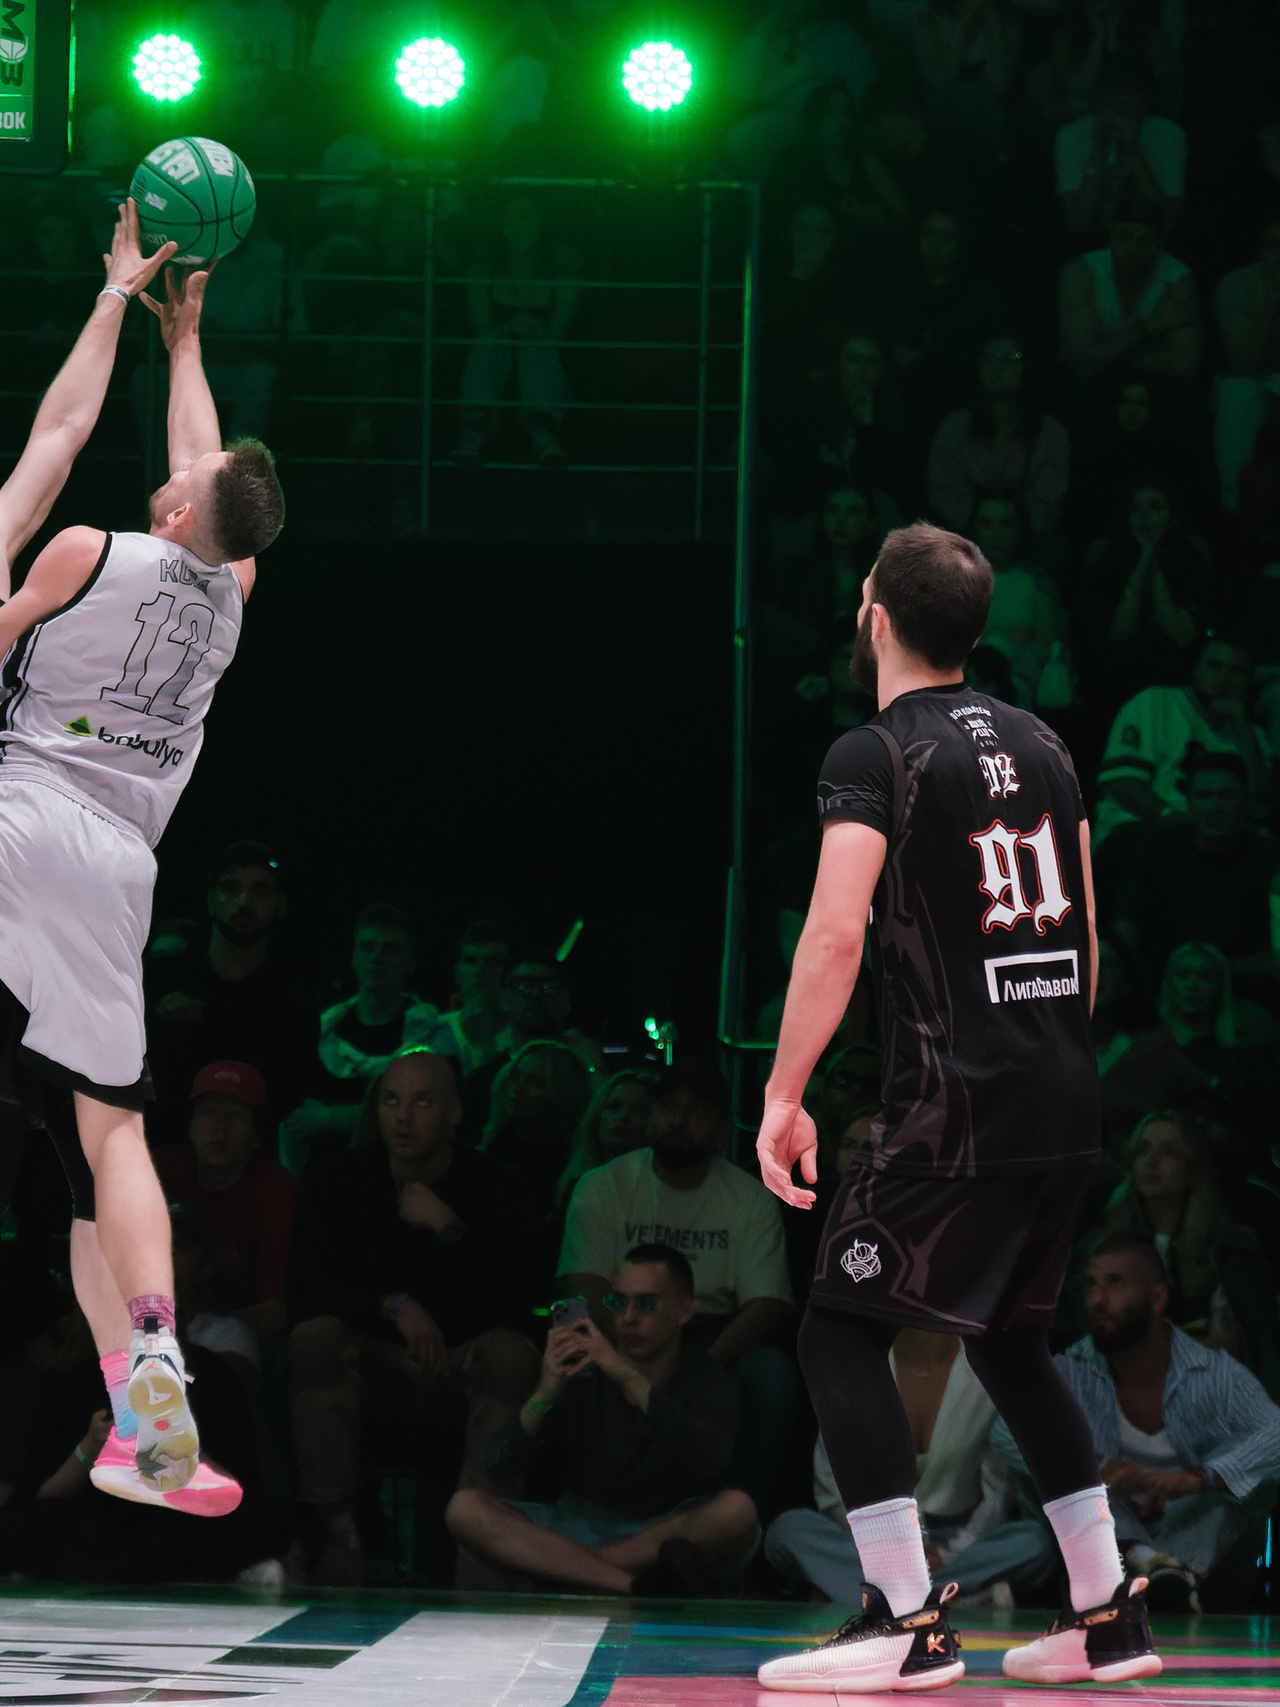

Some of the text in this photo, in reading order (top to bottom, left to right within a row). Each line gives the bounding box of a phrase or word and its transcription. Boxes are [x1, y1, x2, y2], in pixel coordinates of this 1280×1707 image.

[100, 591, 215, 726] 12
[98, 726, 184, 769] babulya
[969, 813, 1072, 937] 91
